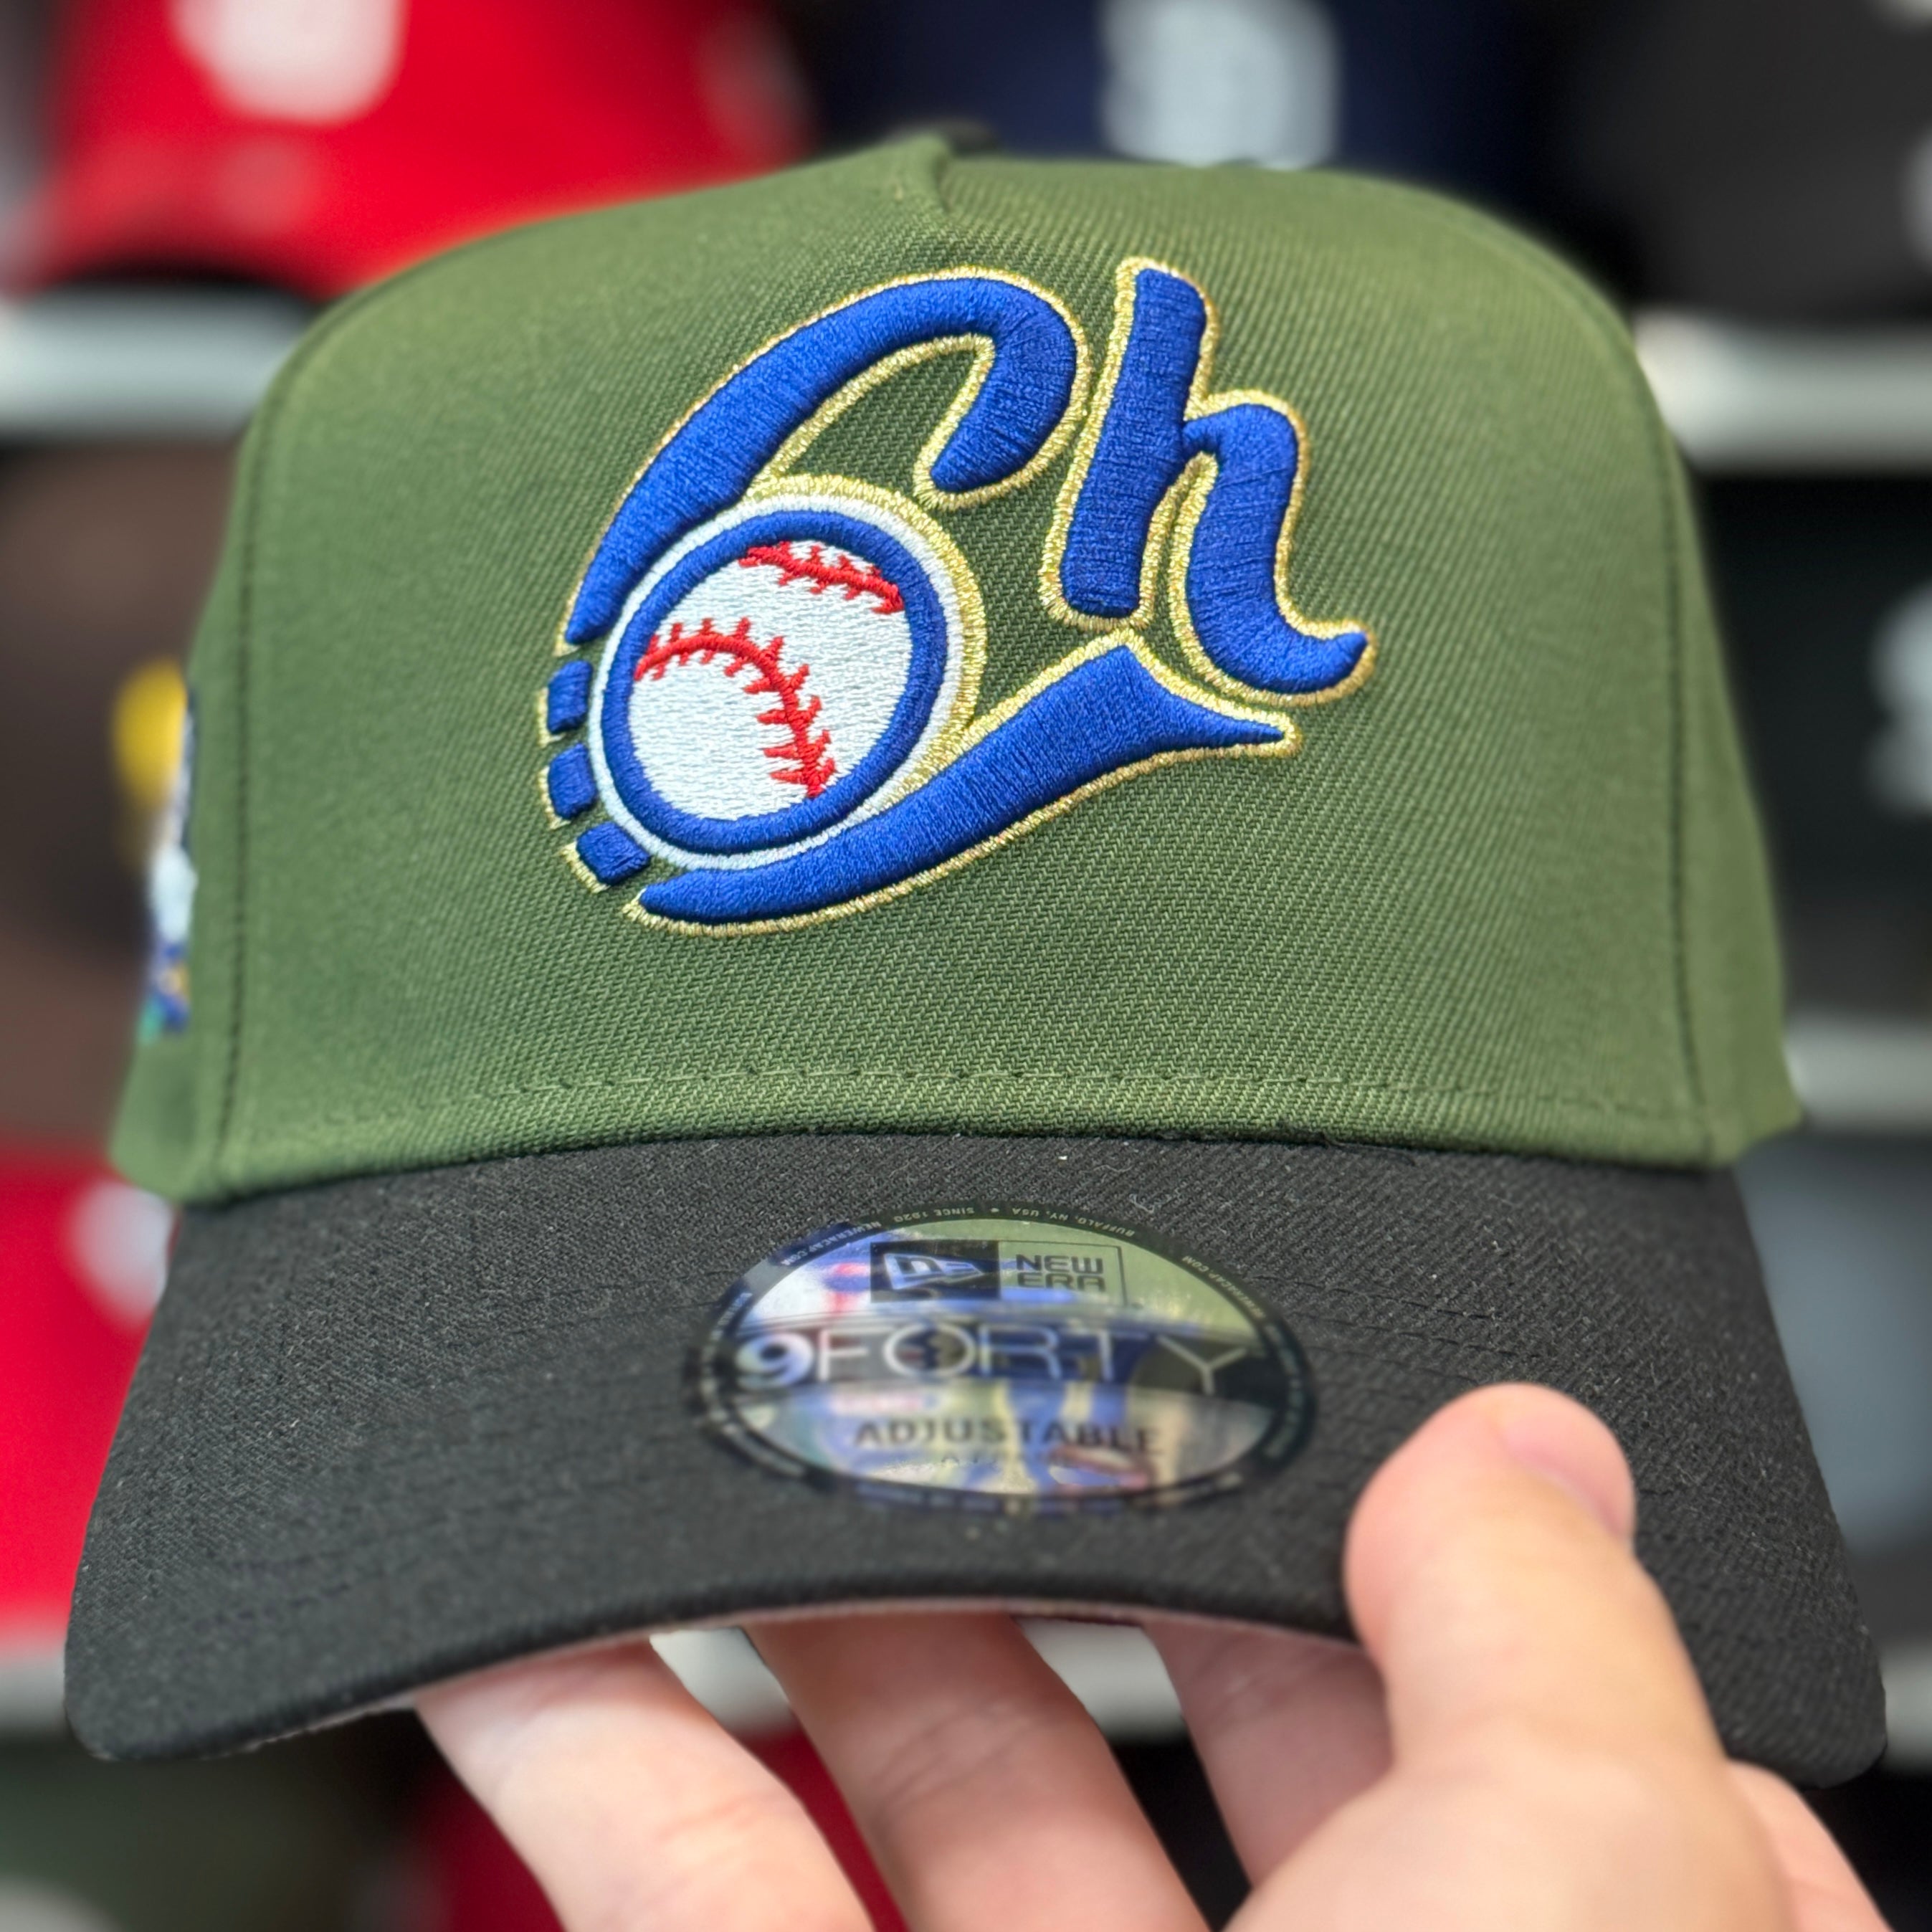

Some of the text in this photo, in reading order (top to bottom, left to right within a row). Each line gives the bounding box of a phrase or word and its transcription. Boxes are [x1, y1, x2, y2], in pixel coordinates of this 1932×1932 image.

[893, 1212, 928, 1222] 1920
[933, 1207, 975, 1216] SINCE
[1012, 1208, 1039, 1217] USA
[1016, 1255, 1104, 1274] NEW
[1017, 1272, 1106, 1291] ERA
[733, 1320, 1250, 1395] 9FORTY
[853, 1417, 1163, 1455] ADJUSTABLE
